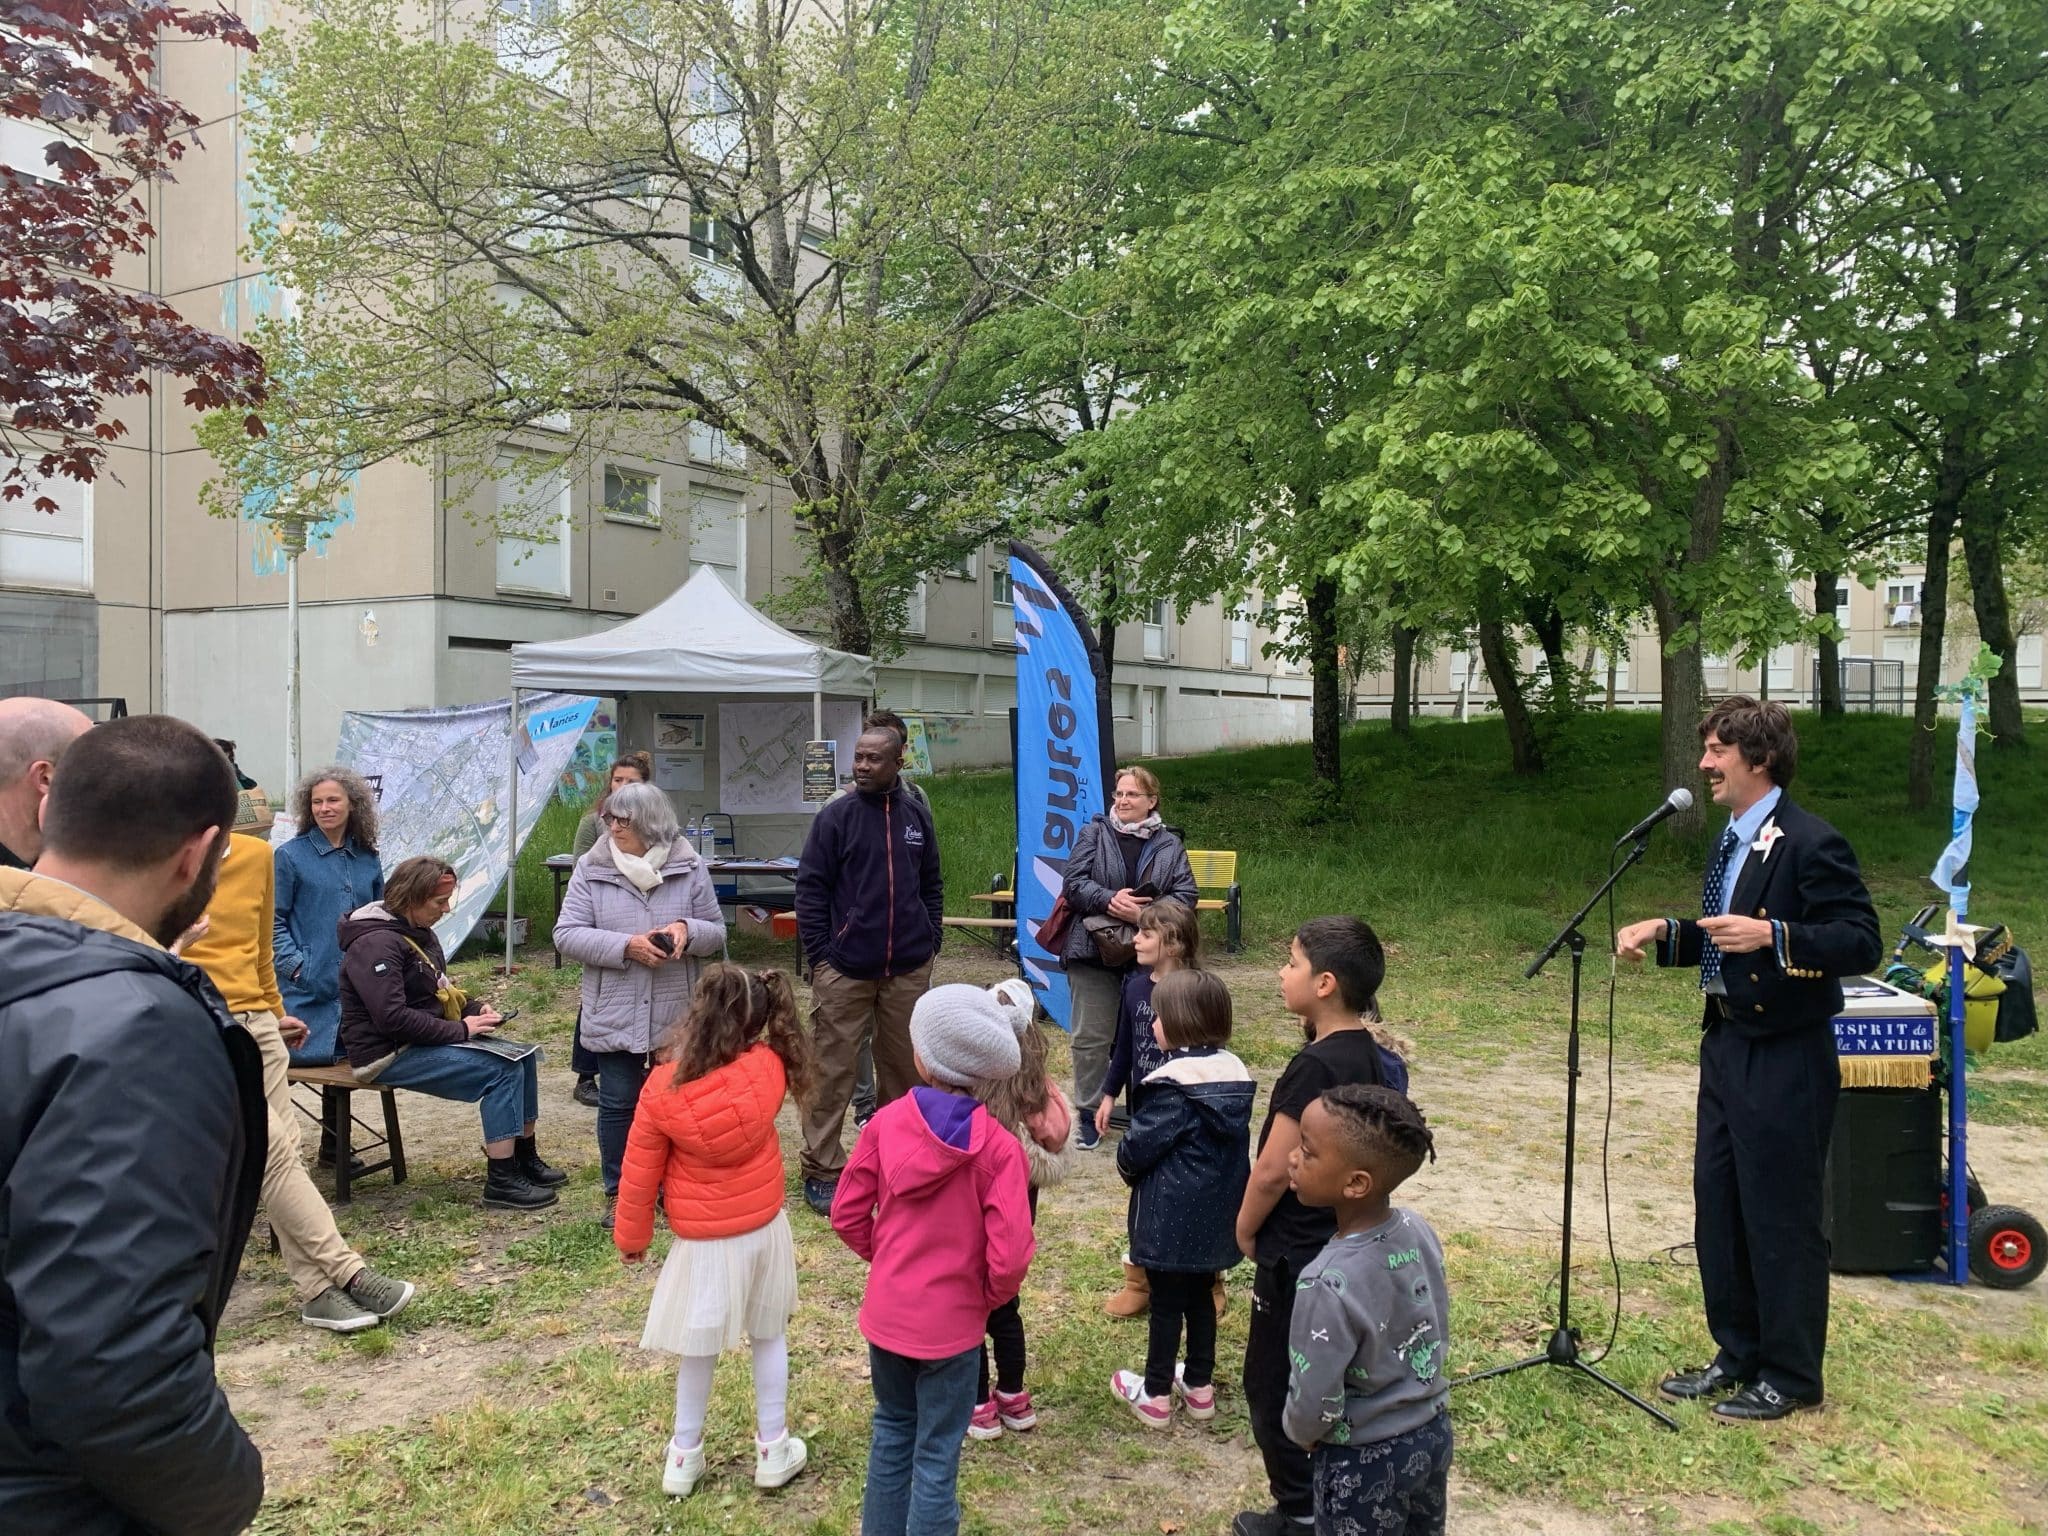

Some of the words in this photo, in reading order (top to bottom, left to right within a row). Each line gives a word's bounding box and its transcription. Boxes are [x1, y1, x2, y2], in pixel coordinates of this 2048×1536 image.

[540, 712, 579, 733] Nantes
[1835, 1023, 1908, 1036] ESPRIT
[1912, 1024, 1927, 1036] de
[1837, 1037, 1851, 1051] la
[1857, 1039, 1933, 1051] NATURE
[1388, 1247, 1420, 1270] RAWR!
